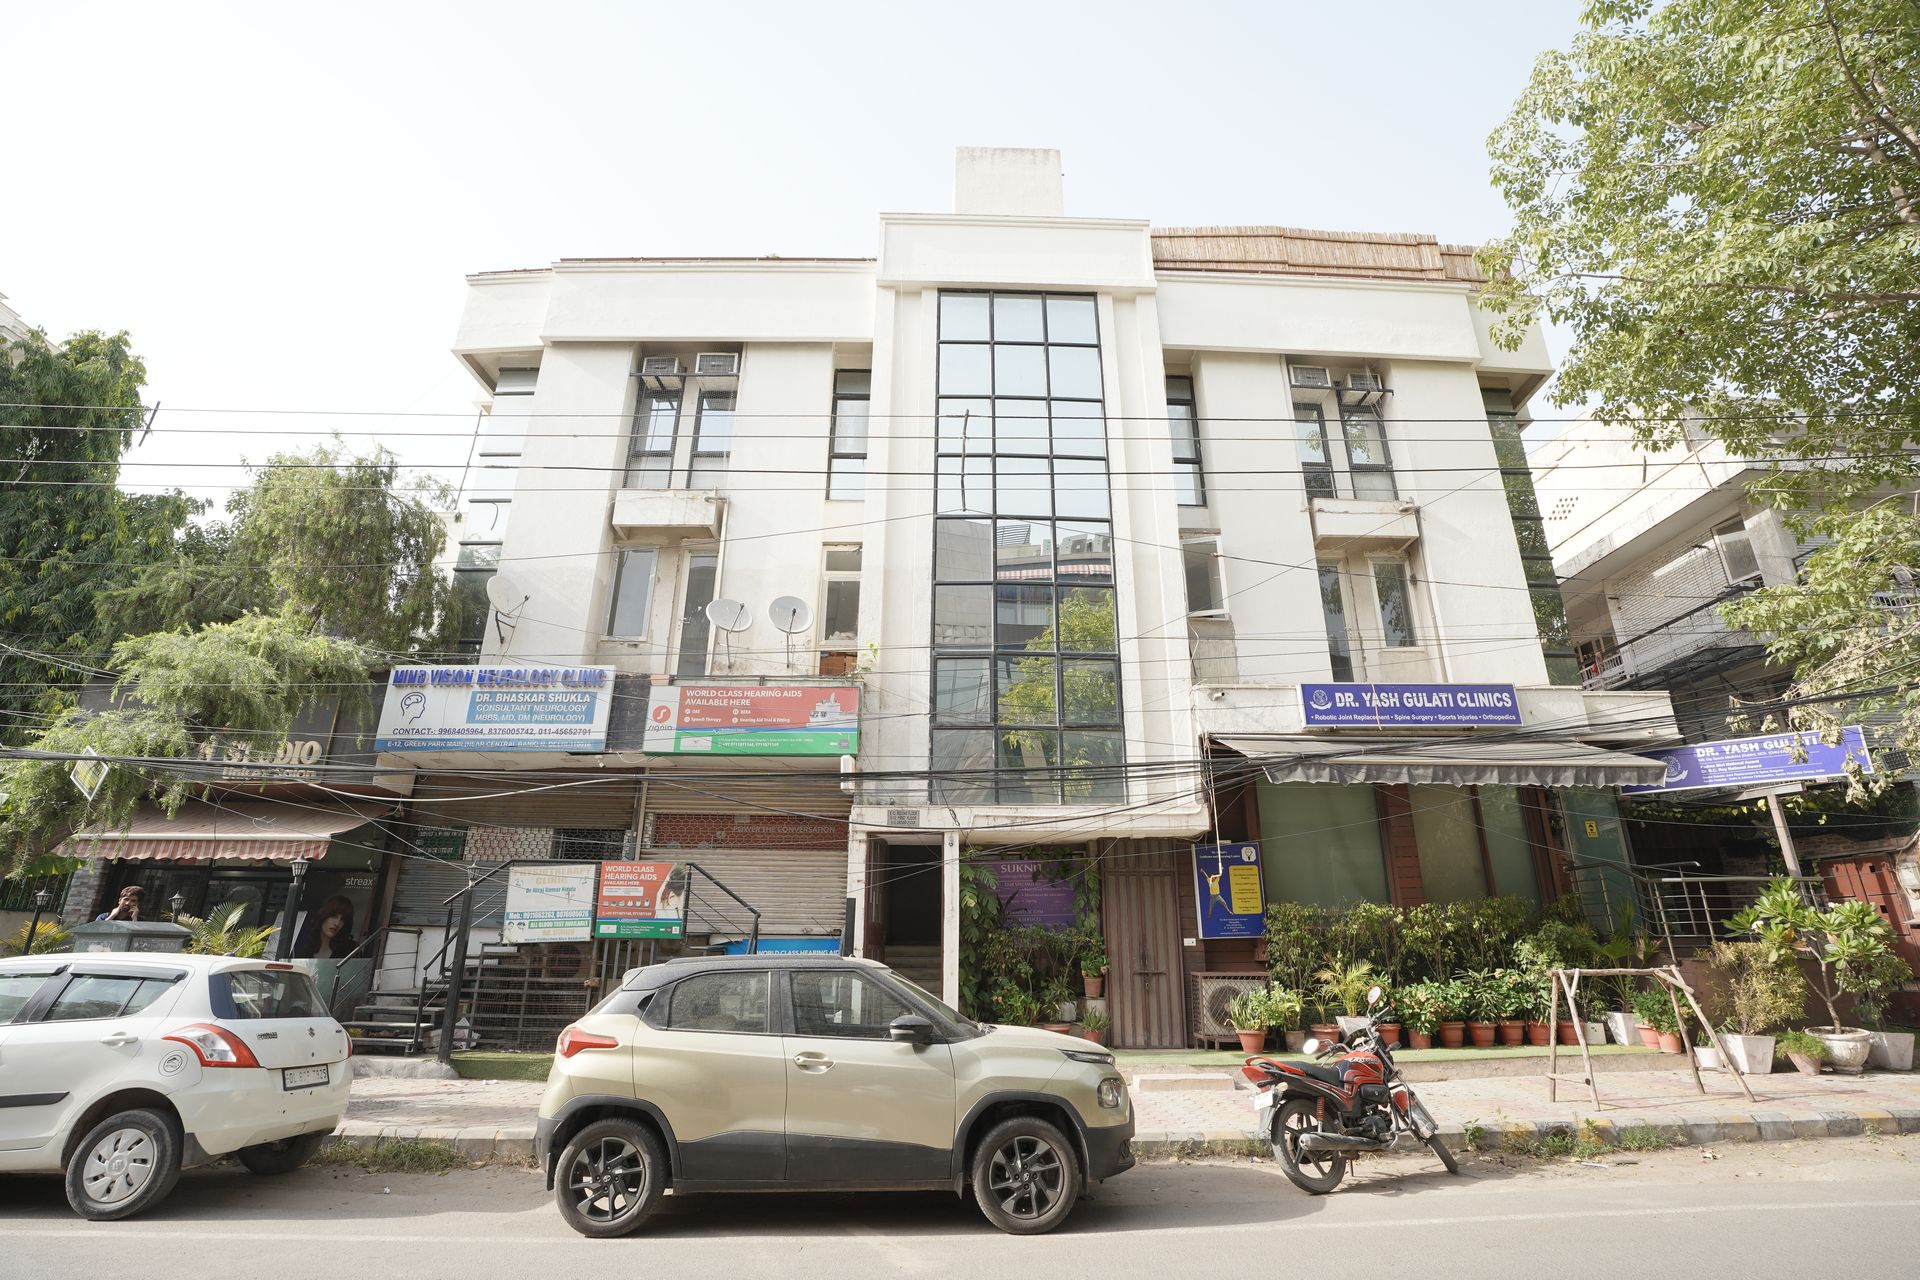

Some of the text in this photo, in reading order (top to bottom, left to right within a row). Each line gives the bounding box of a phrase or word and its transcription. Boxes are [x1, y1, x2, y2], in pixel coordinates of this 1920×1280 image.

[392, 669, 606, 688] MIND VISION NEUROLOGY CLINIC
[476, 692, 590, 703] DR. BHASKAR SHUKLA
[686, 690, 802, 698] WORLD CLASS HEARING AIDS
[685, 698, 729, 706] AVAILABLE
[1335, 692, 1512, 708] DR. YASH GULATI CLINICS
[476, 704, 588, 713] CONSULTANT NEUROLOGY
[518, 714, 530, 723] DM
[532, 714, 586, 723] (NEUROLOGY)
[1315, 714, 1516, 723] Robotic Joint Replacement Spine Surgery Sports Injuries Orthopedics
[648, 725, 673, 733] signia
[404, 740, 427, 749] GREEN
[428, 740, 446, 749] PARK
[1696, 746, 1720, 758] DR.
[1722, 743, 1760, 755] YASH
[1763, 736, 1818, 750] GULTI
[777, 826, 834, 834] CONVERSATION
[345, 876, 373, 886] streax
